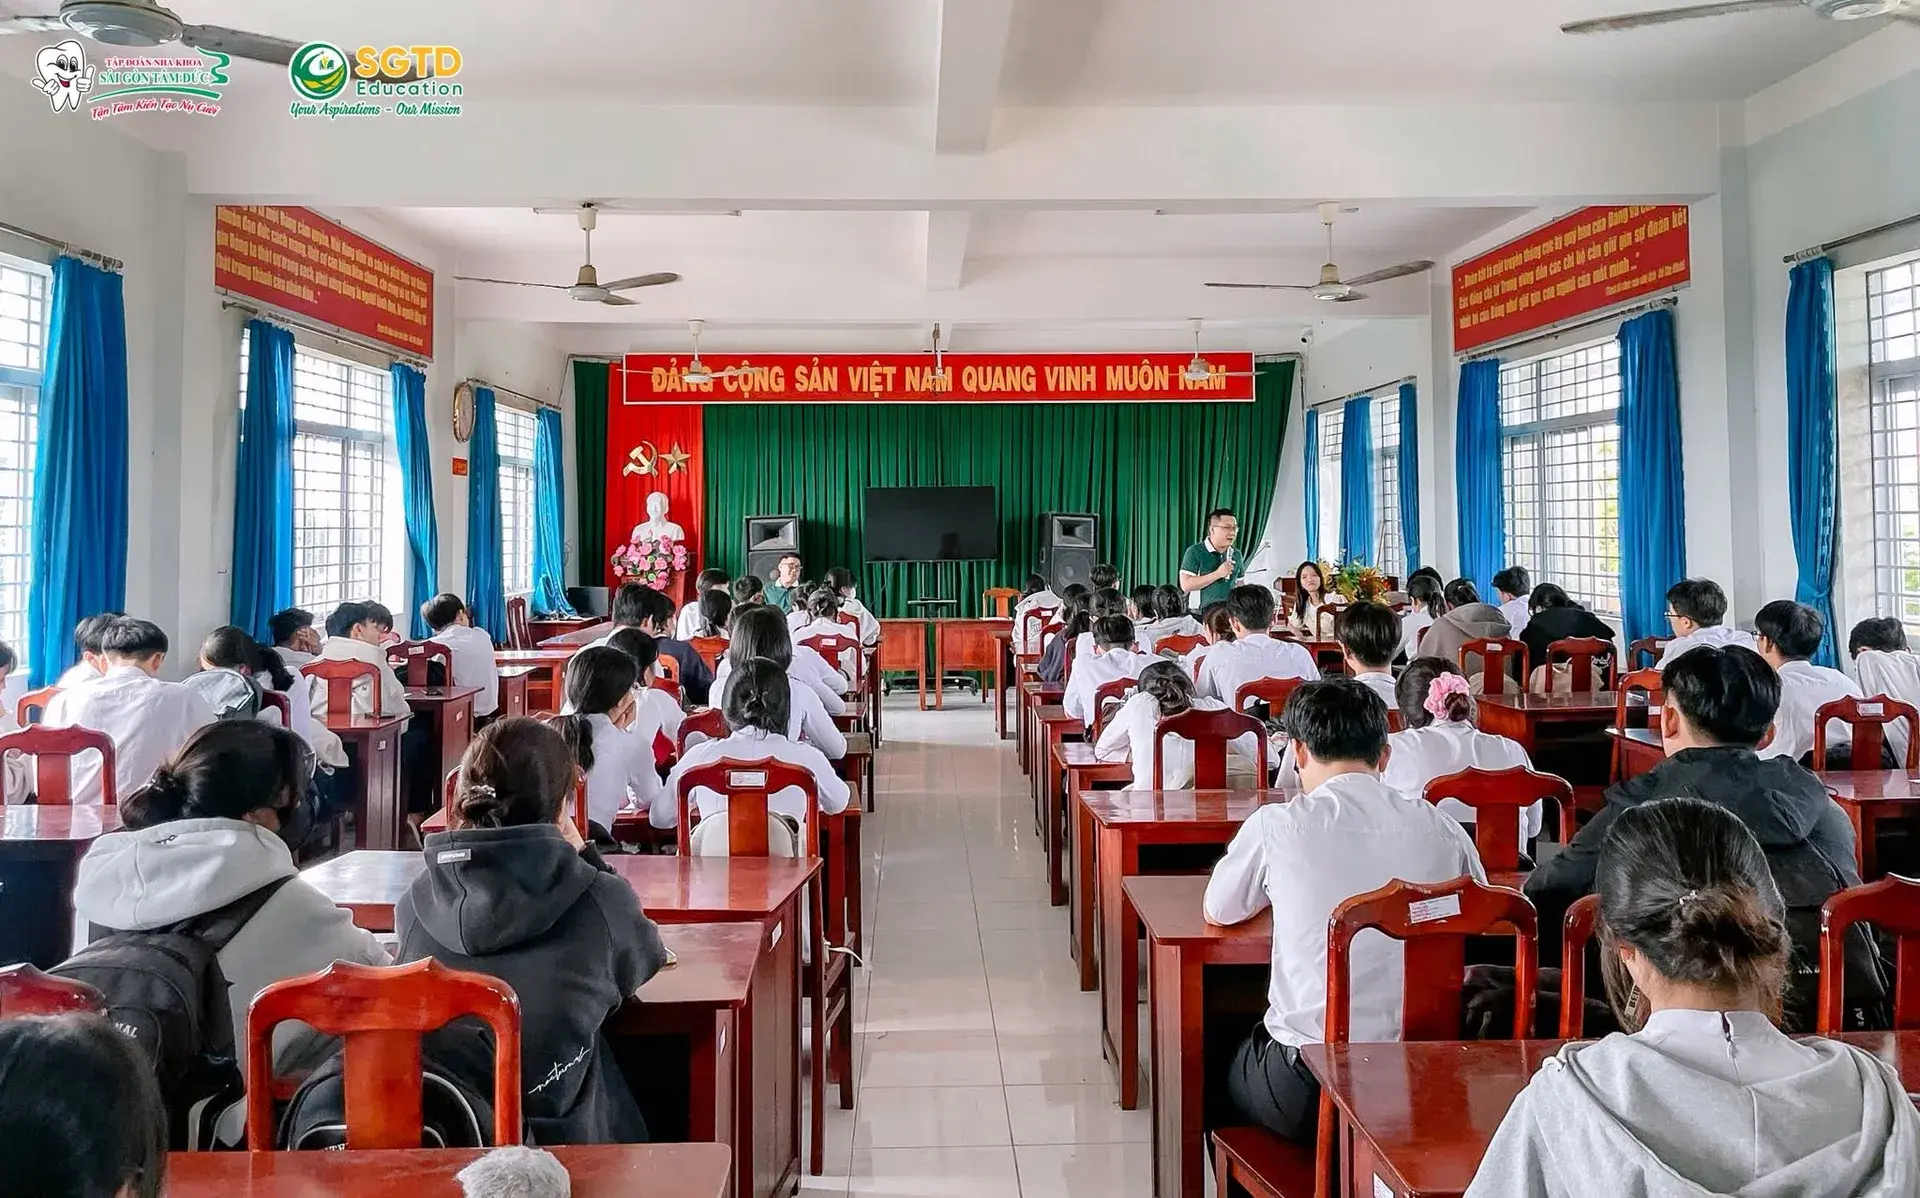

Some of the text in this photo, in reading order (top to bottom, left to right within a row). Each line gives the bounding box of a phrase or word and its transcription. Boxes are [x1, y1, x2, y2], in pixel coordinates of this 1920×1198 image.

[723, 359, 785, 398] CỘNG
[795, 357, 838, 392] SẢN
[848, 360, 897, 398] VIỆT
[905, 366, 953, 392] NAM
[962, 366, 1037, 393] QUANG
[1044, 366, 1097, 391] VINH
[1106, 359, 1169, 391] MUÔN
